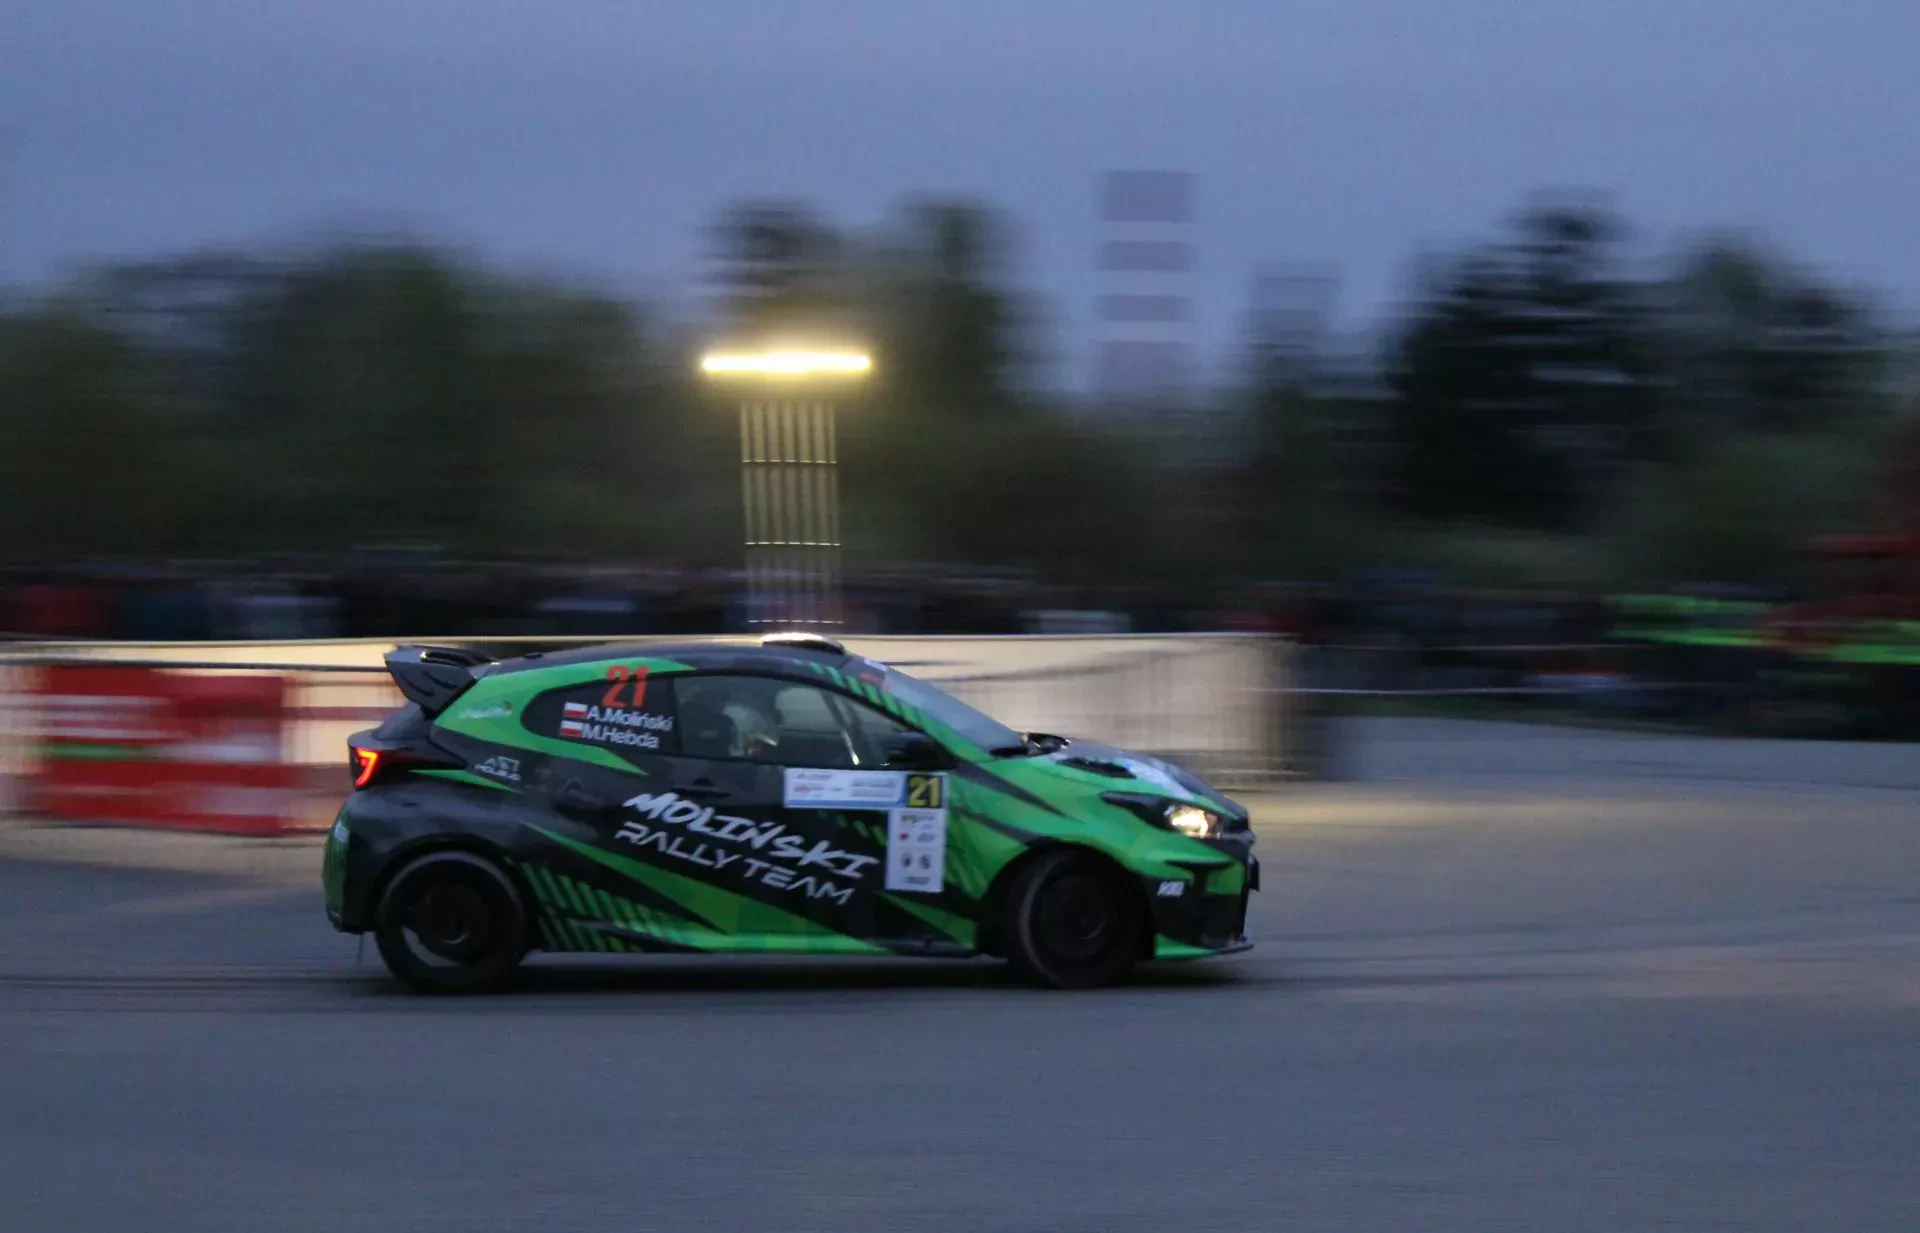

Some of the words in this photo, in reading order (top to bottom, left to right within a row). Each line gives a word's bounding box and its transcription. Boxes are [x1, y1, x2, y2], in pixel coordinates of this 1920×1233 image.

[602, 665, 648, 708] 21
[581, 722, 660, 749] M.Hebda
[908, 774, 941, 807] 21
[622, 792, 880, 879] MOLIŃSKI
[614, 821, 742, 869] RALLY
[744, 857, 855, 905] TEAM
